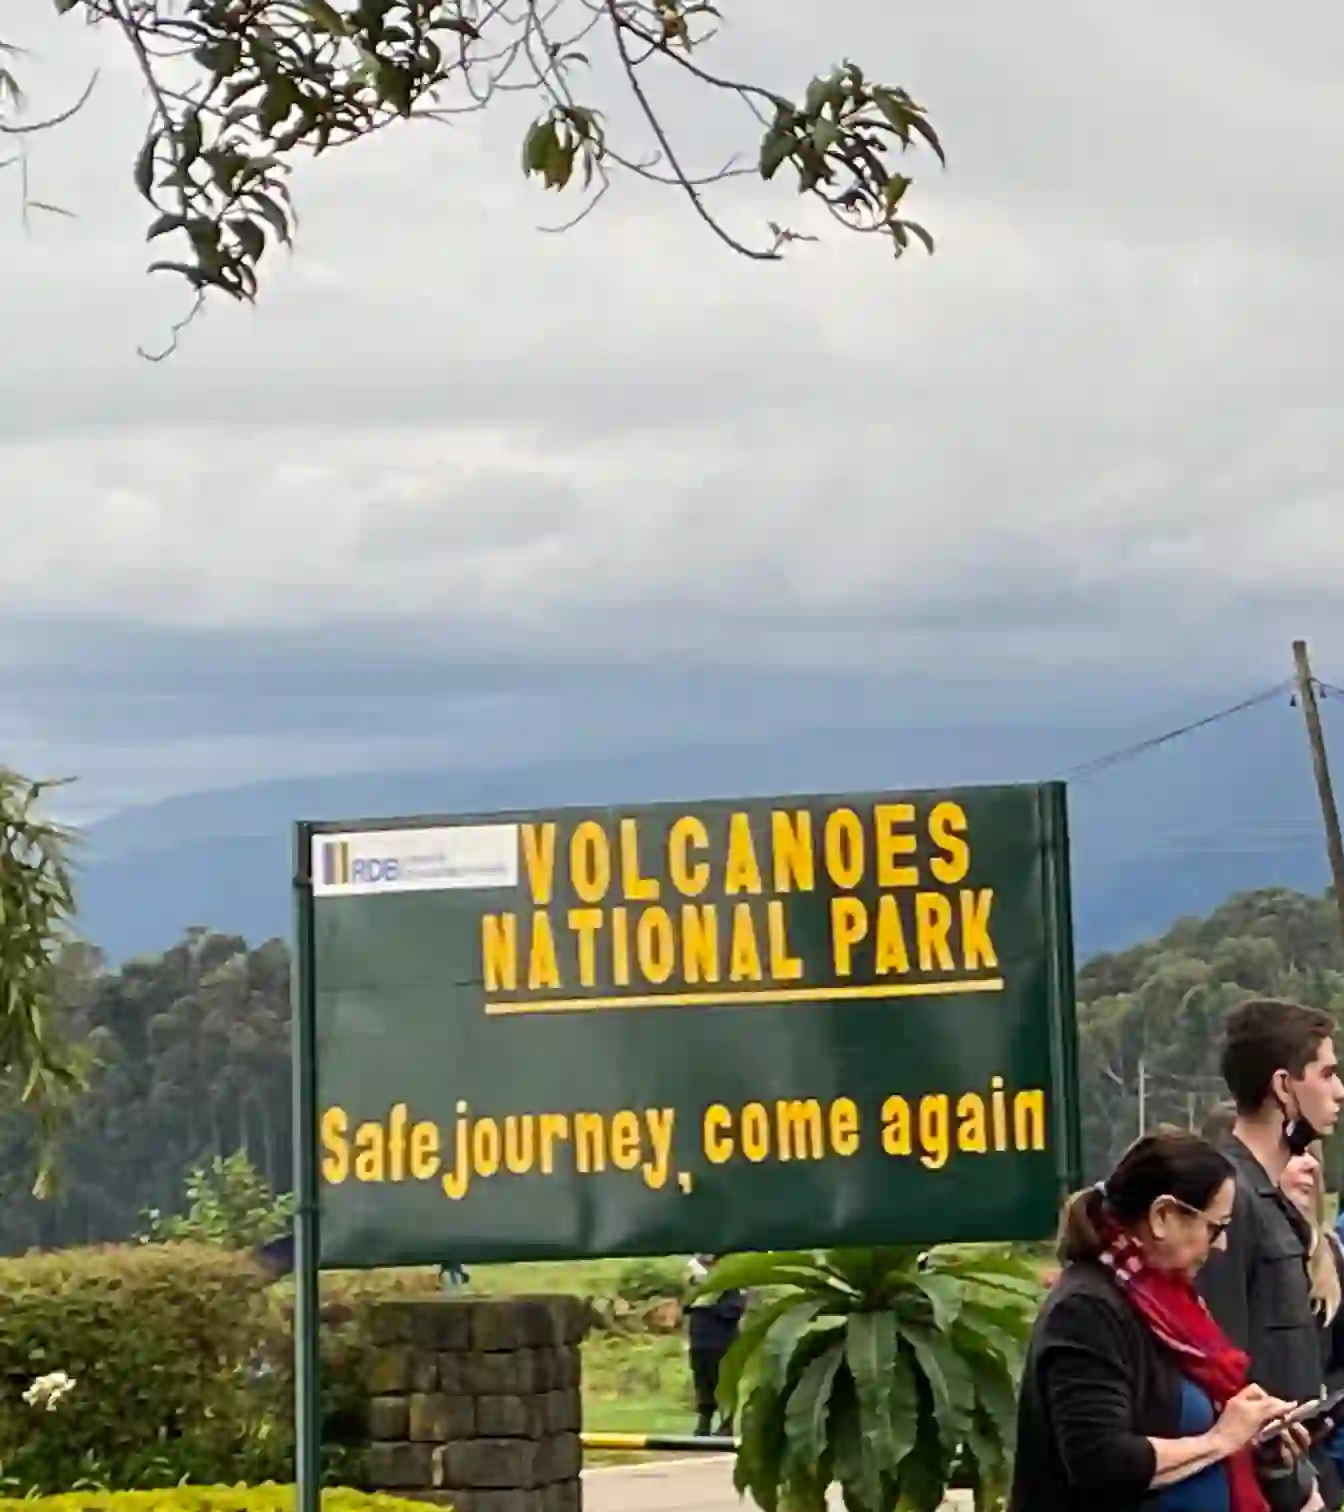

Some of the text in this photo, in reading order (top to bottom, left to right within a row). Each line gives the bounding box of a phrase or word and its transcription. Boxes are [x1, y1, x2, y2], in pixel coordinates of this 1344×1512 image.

[518, 802, 970, 906] VOLCANOES
[482, 888, 997, 992] NATIONAL PARK
[703, 1091, 859, 1164] come
[882, 1078, 1045, 1169] again
